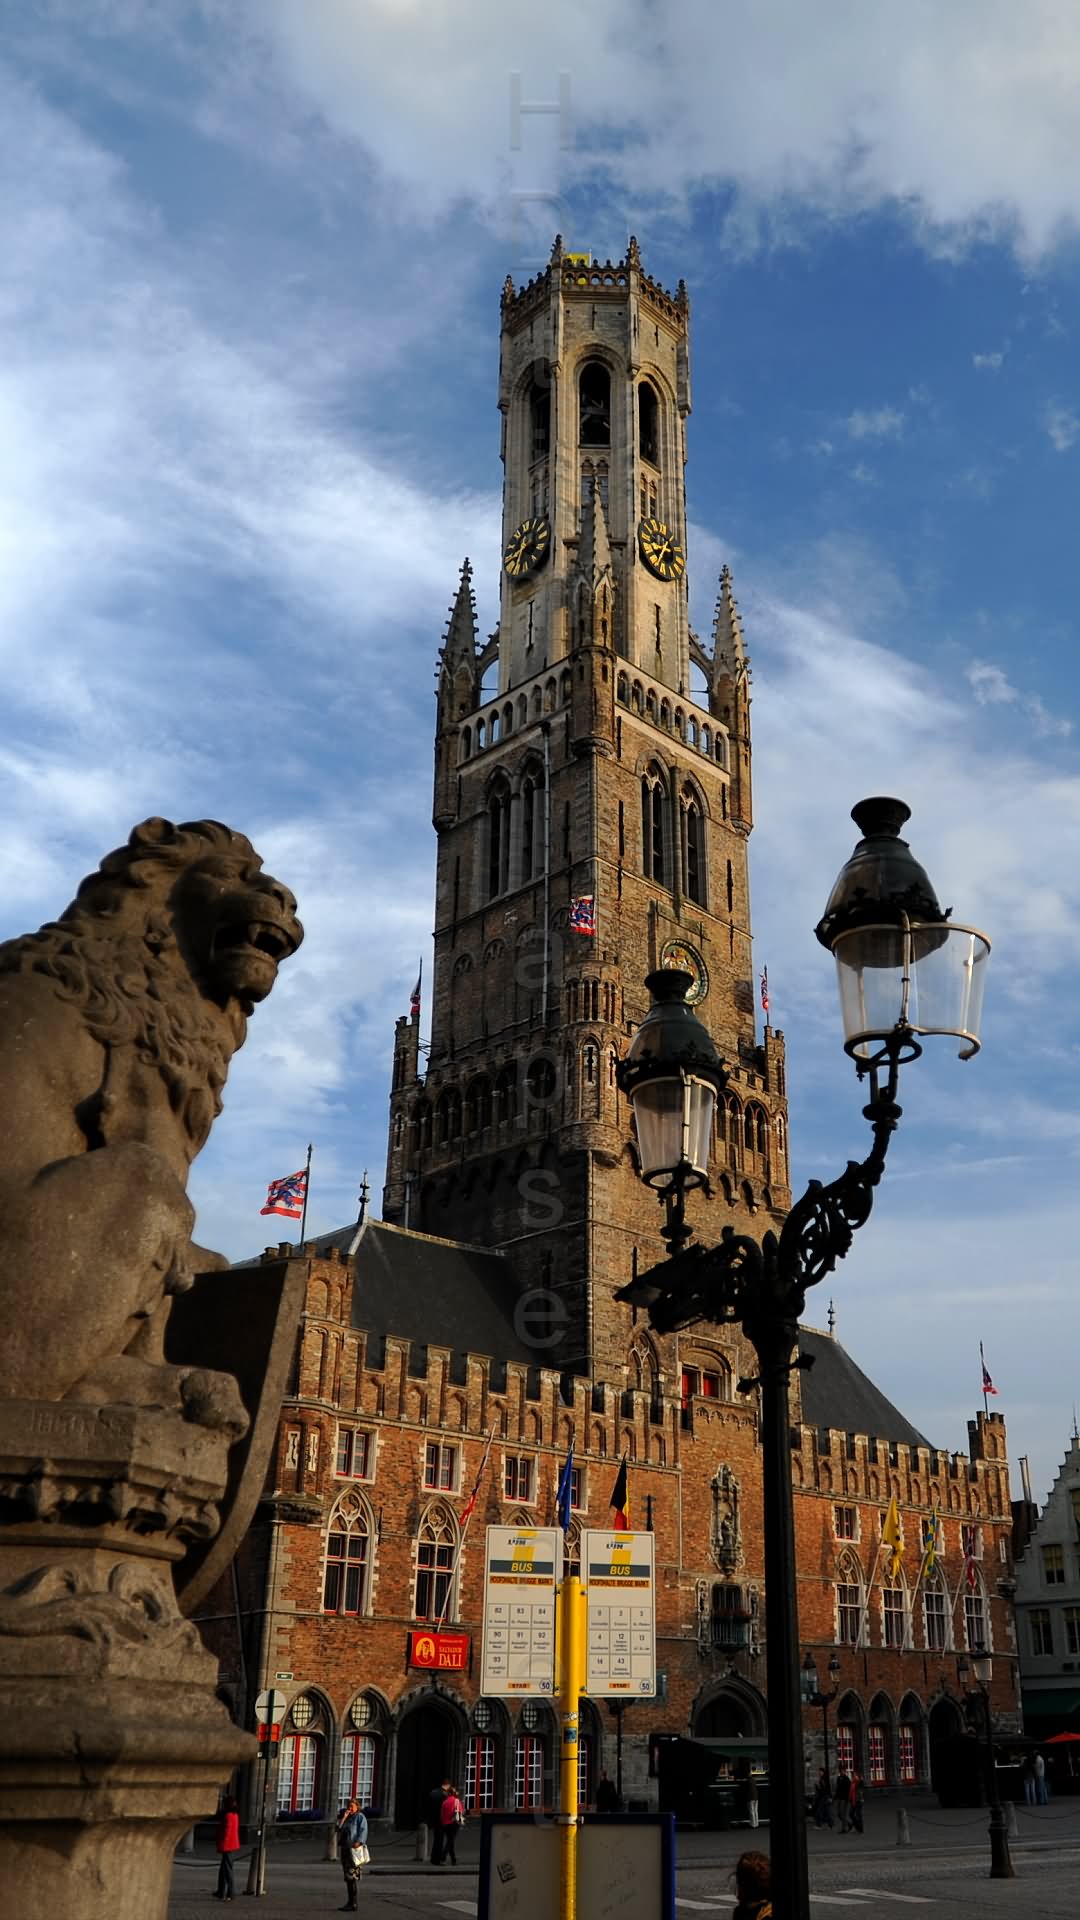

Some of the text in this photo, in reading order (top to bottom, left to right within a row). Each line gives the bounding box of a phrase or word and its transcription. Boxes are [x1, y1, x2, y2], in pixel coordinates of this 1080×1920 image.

[511, 1562, 534, 1572] BUS
[609, 1566, 631, 1575] BUS
[438, 1653, 462, 1667] DALI
[541, 1682, 550, 1690] 50
[641, 1682, 650, 1690] 50
